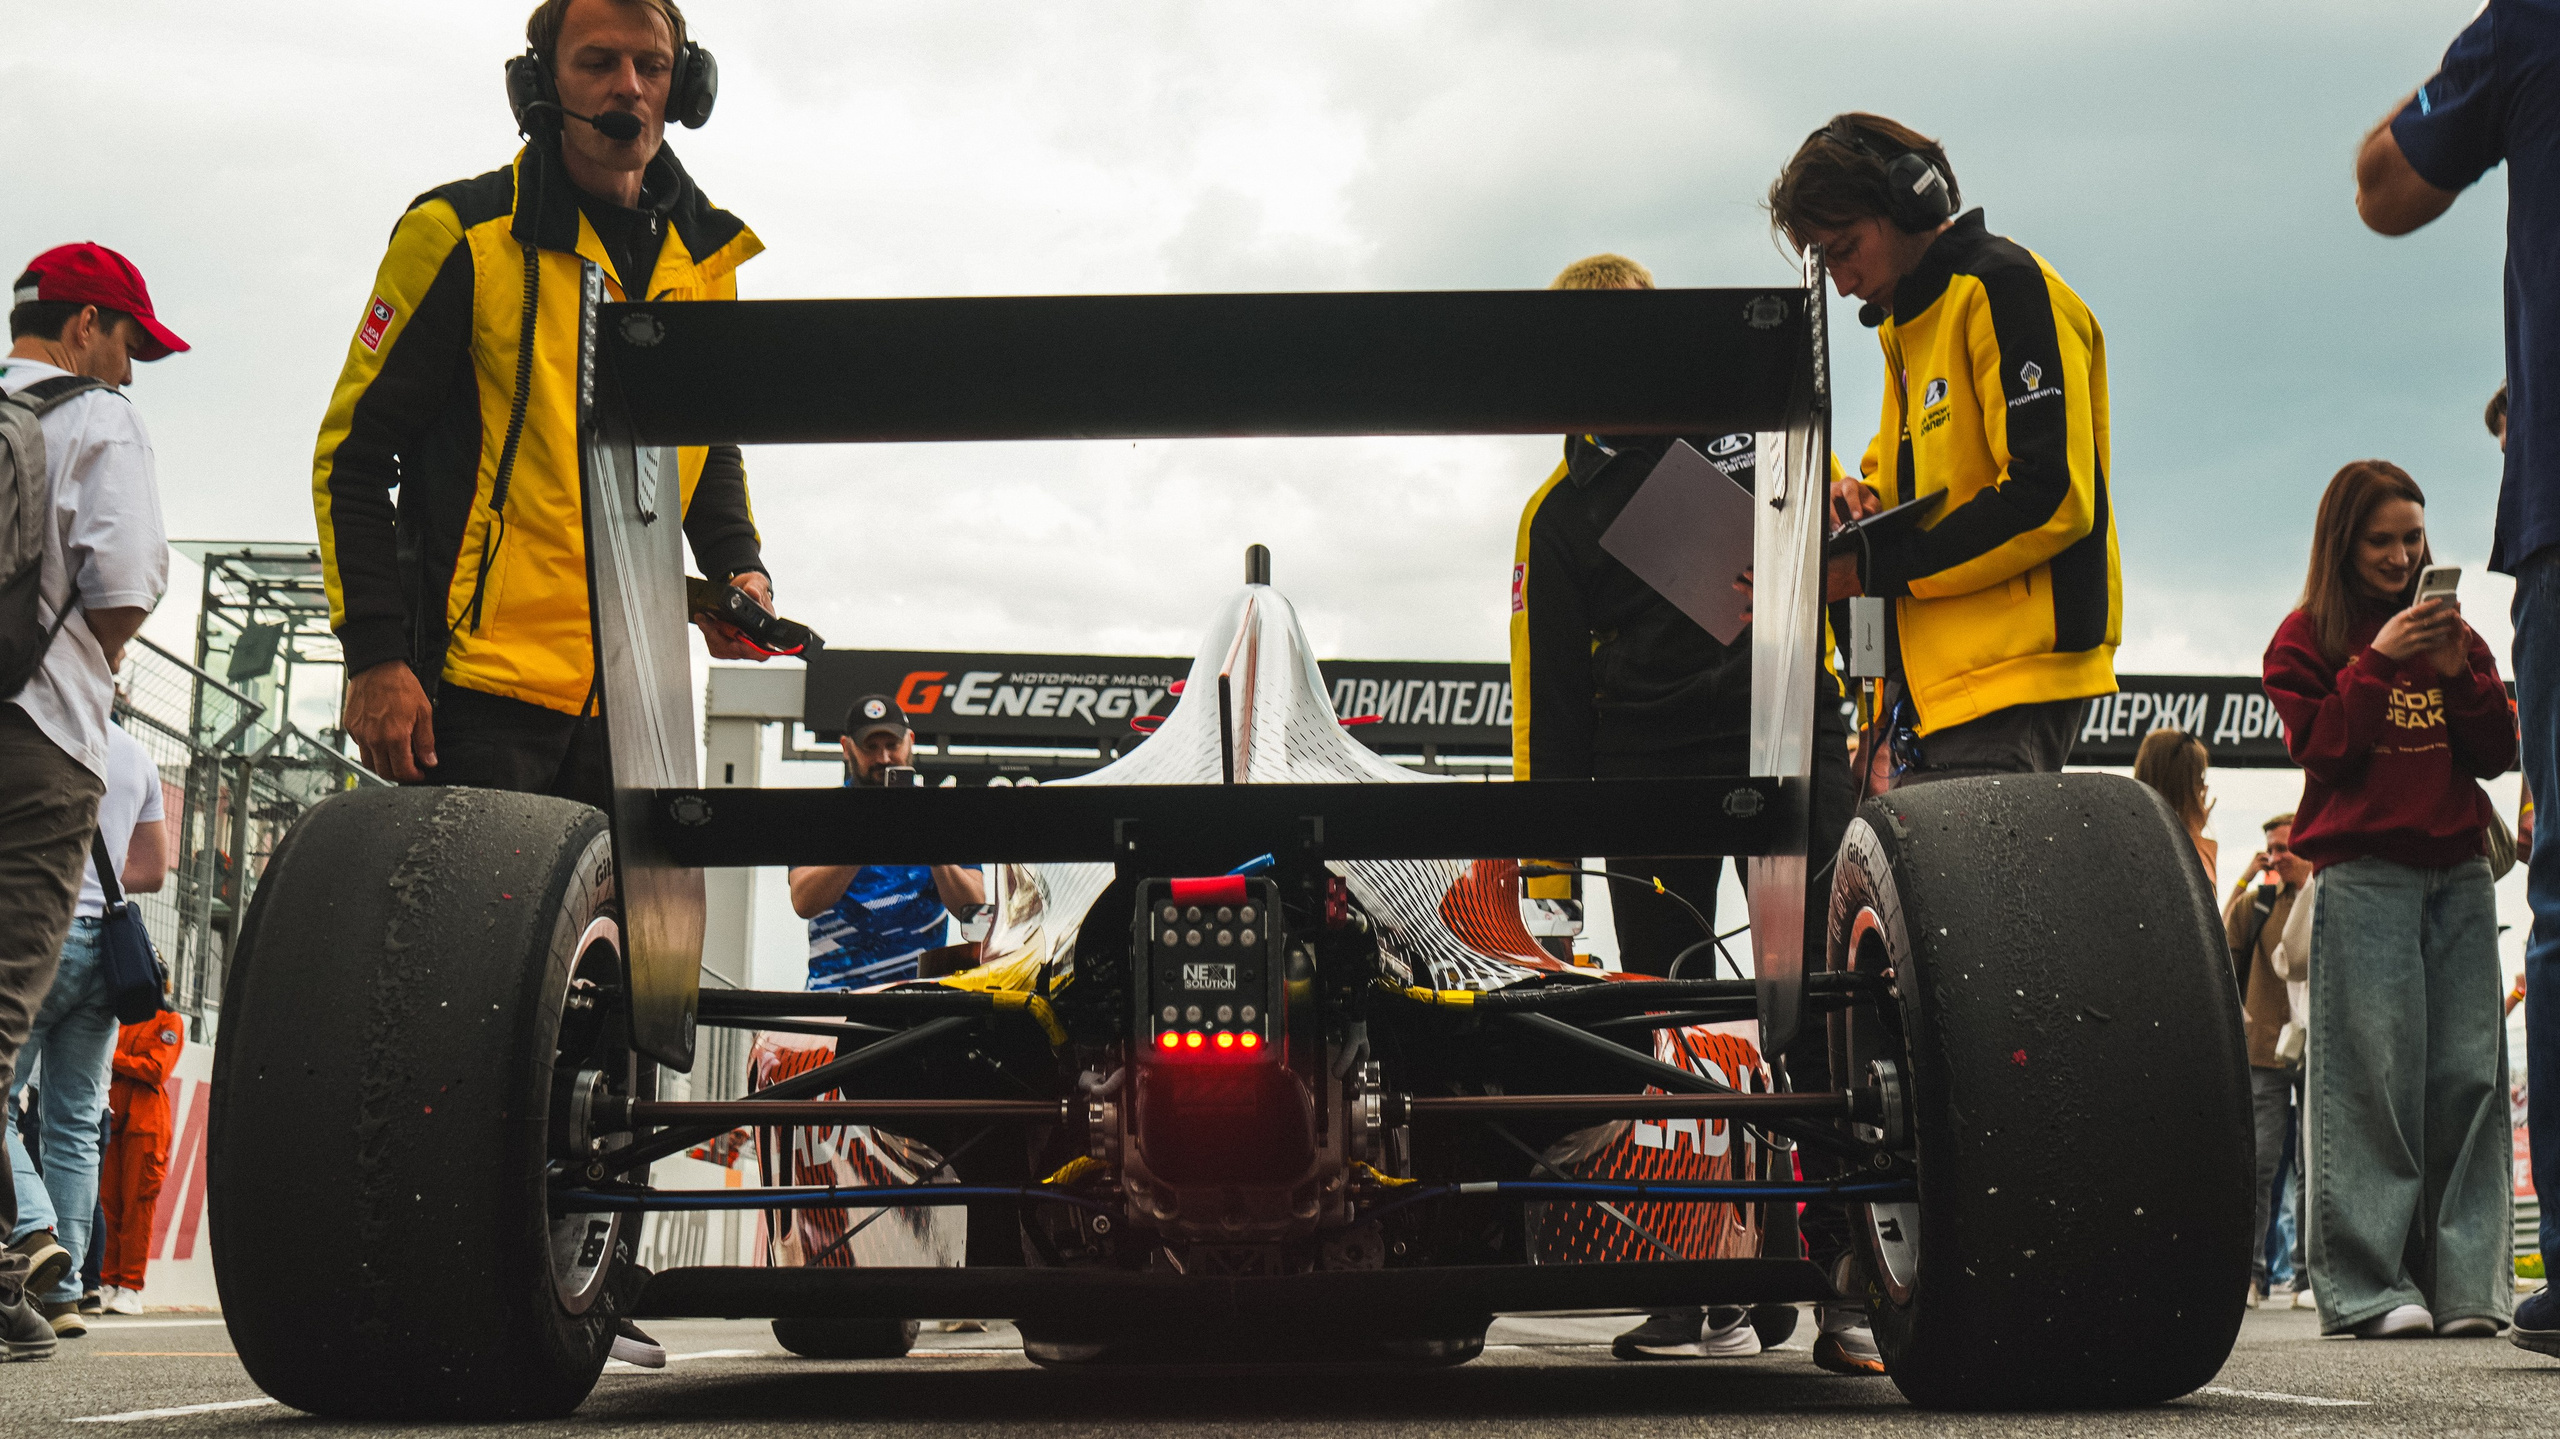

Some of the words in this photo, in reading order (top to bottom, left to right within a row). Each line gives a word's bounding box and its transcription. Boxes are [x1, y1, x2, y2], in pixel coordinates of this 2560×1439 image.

[1009, 672, 1109, 687] МОТОРНОЕ
[1332, 678, 1514, 729] ДВИГАТЕЛЬ
[2081, 692, 2210, 744] ДЕРЖИ
[1183, 963, 1235, 980] NEXT
[1185, 979, 1236, 989] SOLUTION
